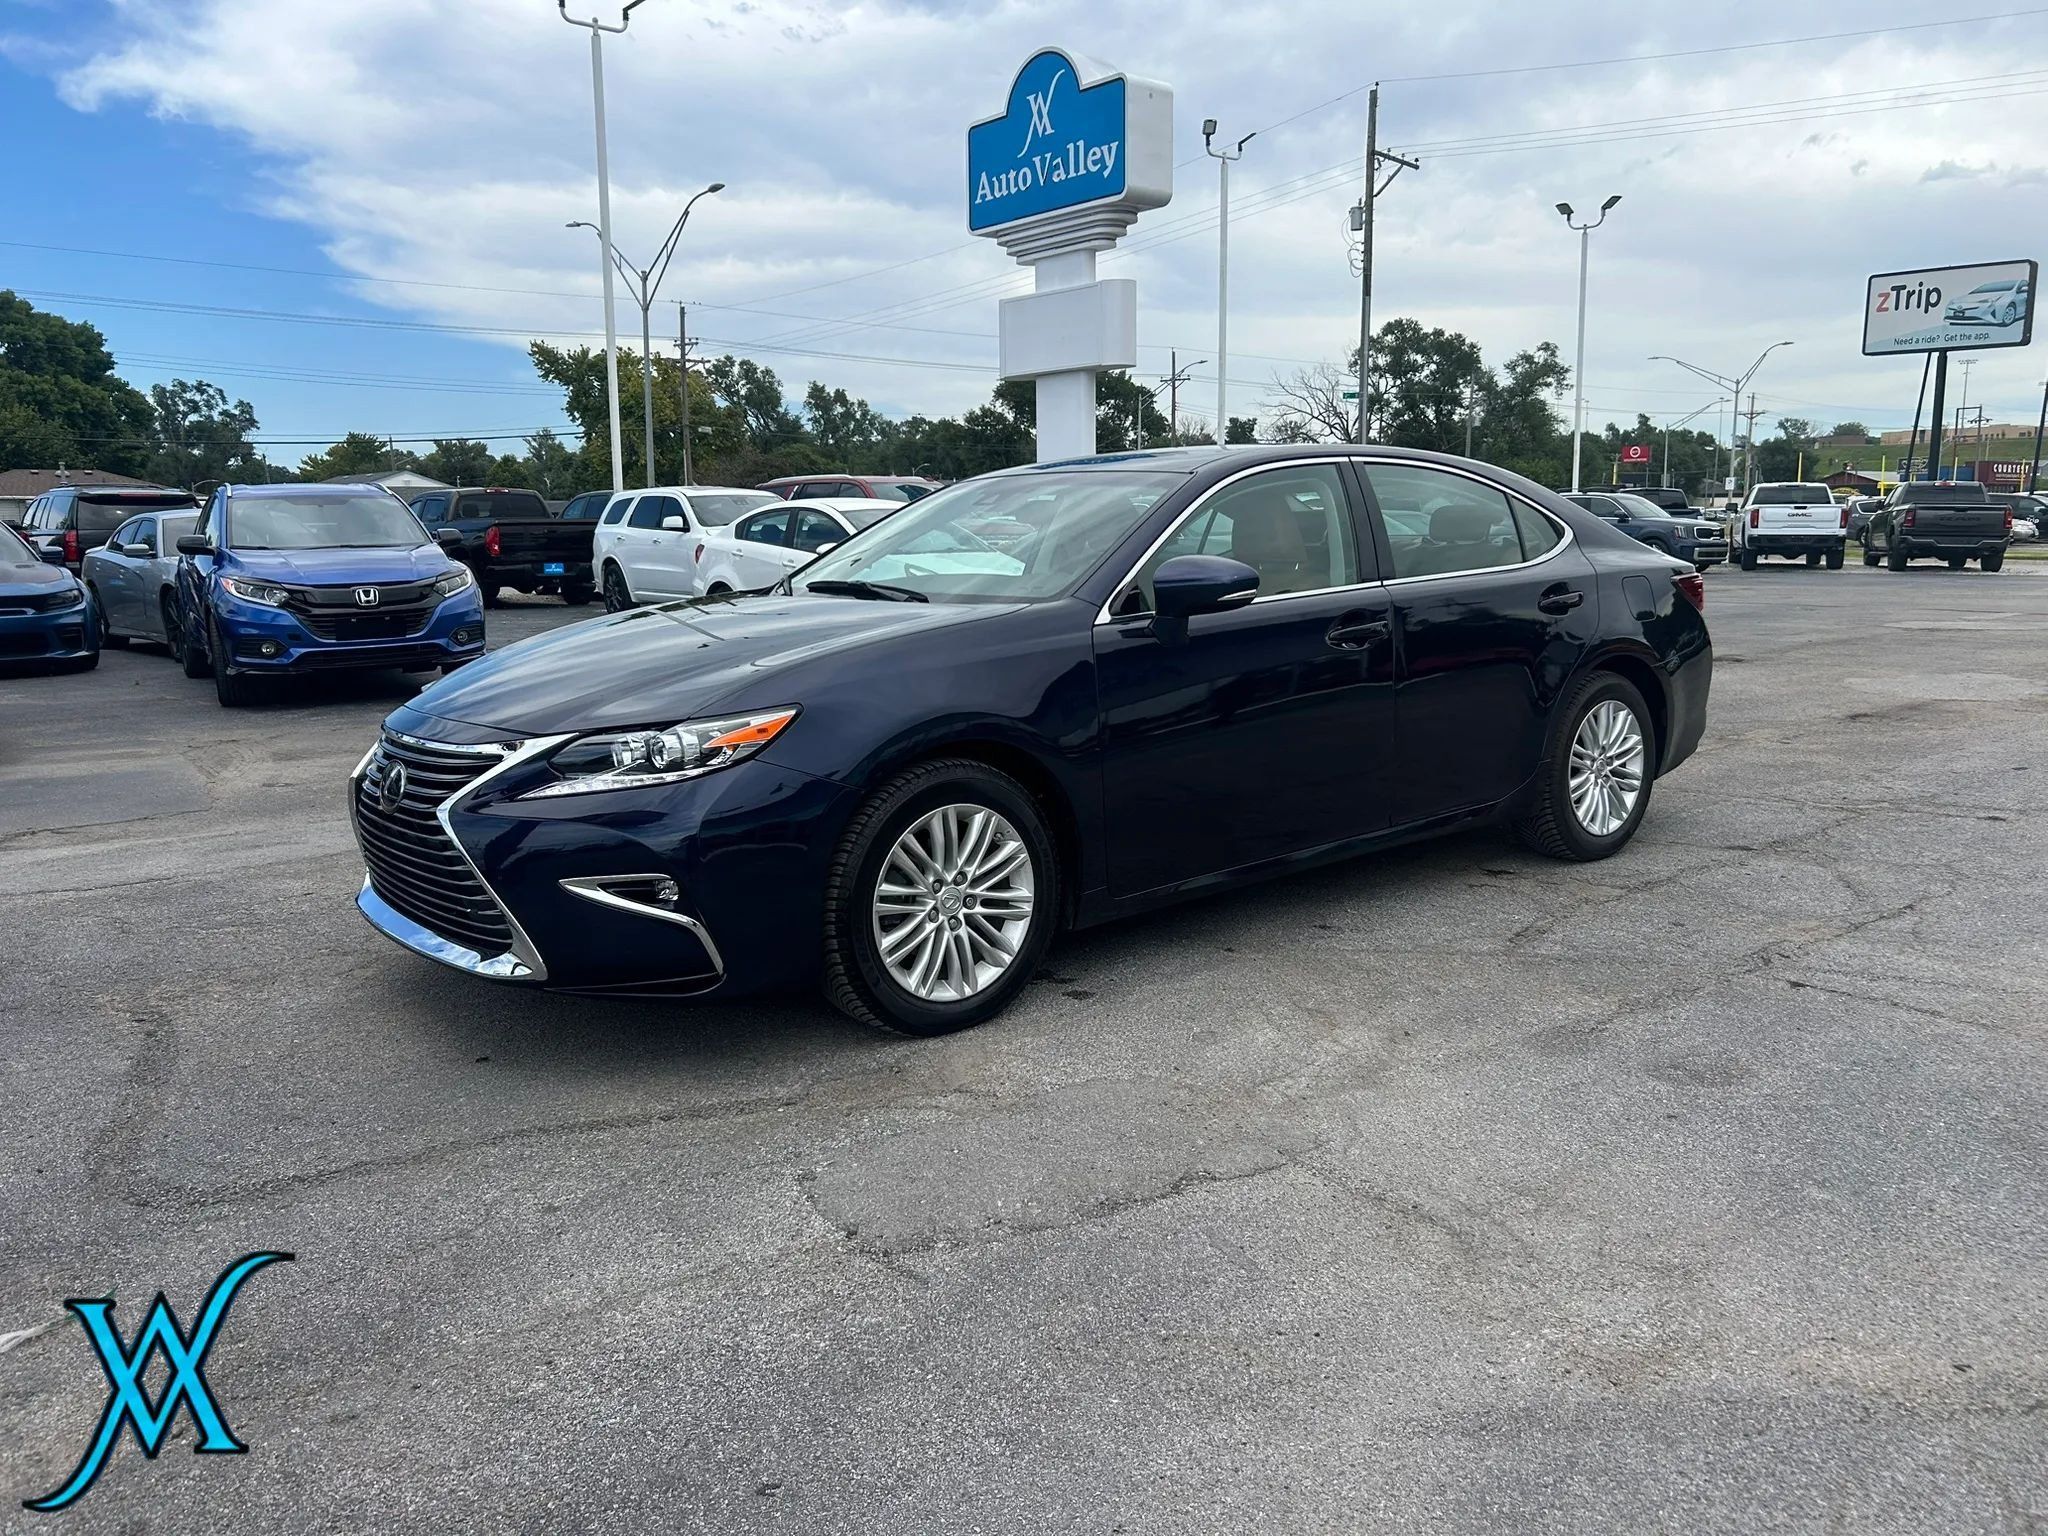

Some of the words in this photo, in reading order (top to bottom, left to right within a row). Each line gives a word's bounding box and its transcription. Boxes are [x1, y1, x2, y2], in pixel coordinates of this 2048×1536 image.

[1876, 281, 1942, 314] zTrip
[1894, 336, 1913, 345] Need
[1921, 334, 1941, 343] ride?
[1944, 333, 1958, 342] Get
[1960, 333, 1972, 341] the
